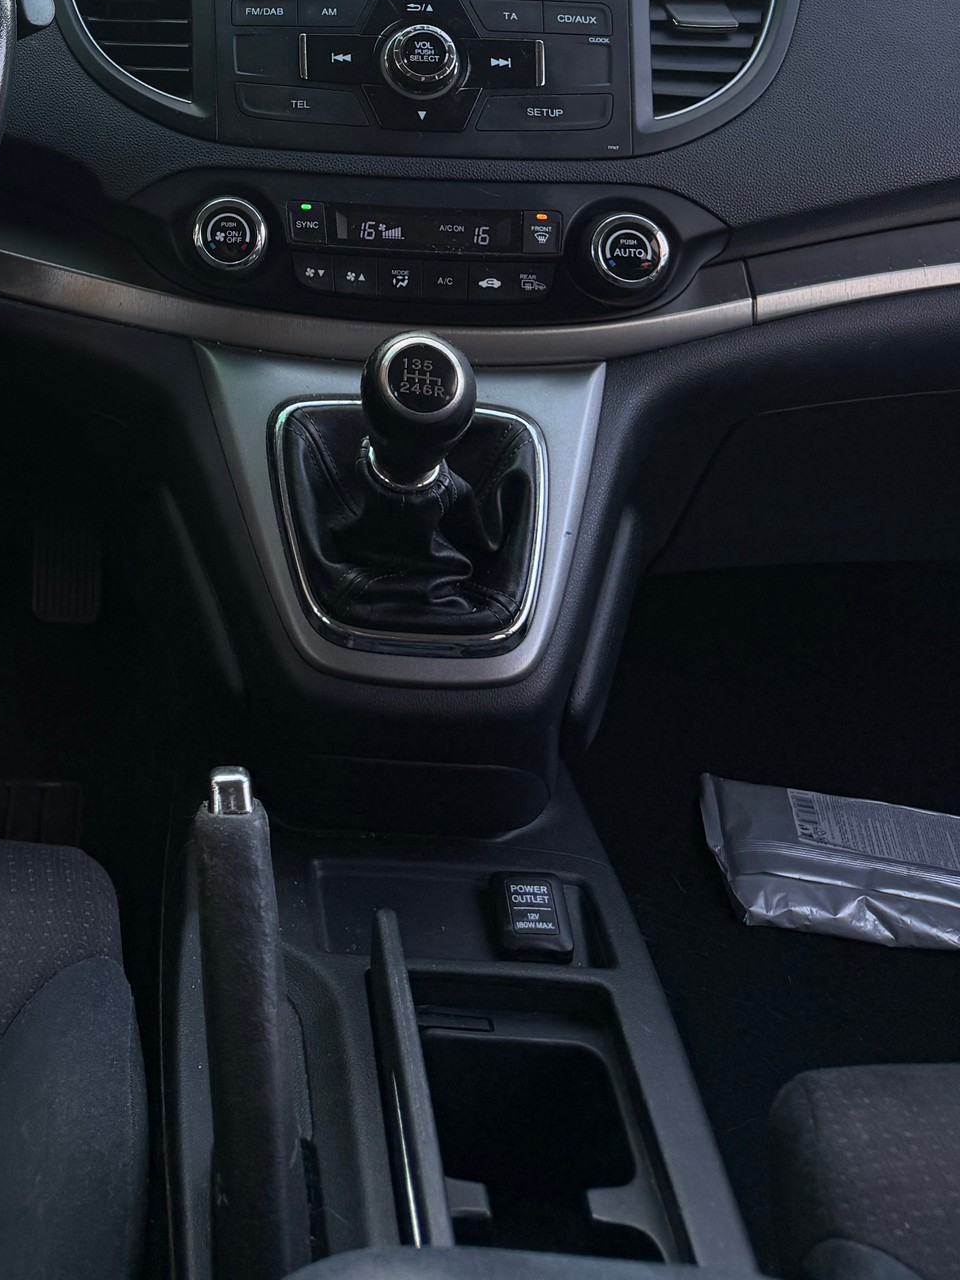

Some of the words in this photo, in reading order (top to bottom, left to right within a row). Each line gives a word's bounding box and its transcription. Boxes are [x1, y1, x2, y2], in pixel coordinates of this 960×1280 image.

[245, 7, 284, 16] FM/DAB
[321, 7, 337, 16] AM
[503, 12, 518, 21] TA
[557, 14, 597, 25] CD/AUX
[414, 41, 434, 49] VOL
[291, 100, 310, 109] TEL
[526, 107, 564, 117] SETUP
[296, 221, 319, 229] SYNC
[453, 225, 465, 233] ON
[360, 221, 376, 240] 16
[473, 227, 490, 245] 16
[613, 248, 645, 258] AUTO
[437, 277, 453, 286] A/C
[510, 884, 548, 894] POWER
[511, 894, 549, 904] OUTLET
[527, 912, 540, 920] 12V
[516, 921, 535, 929] 180W
